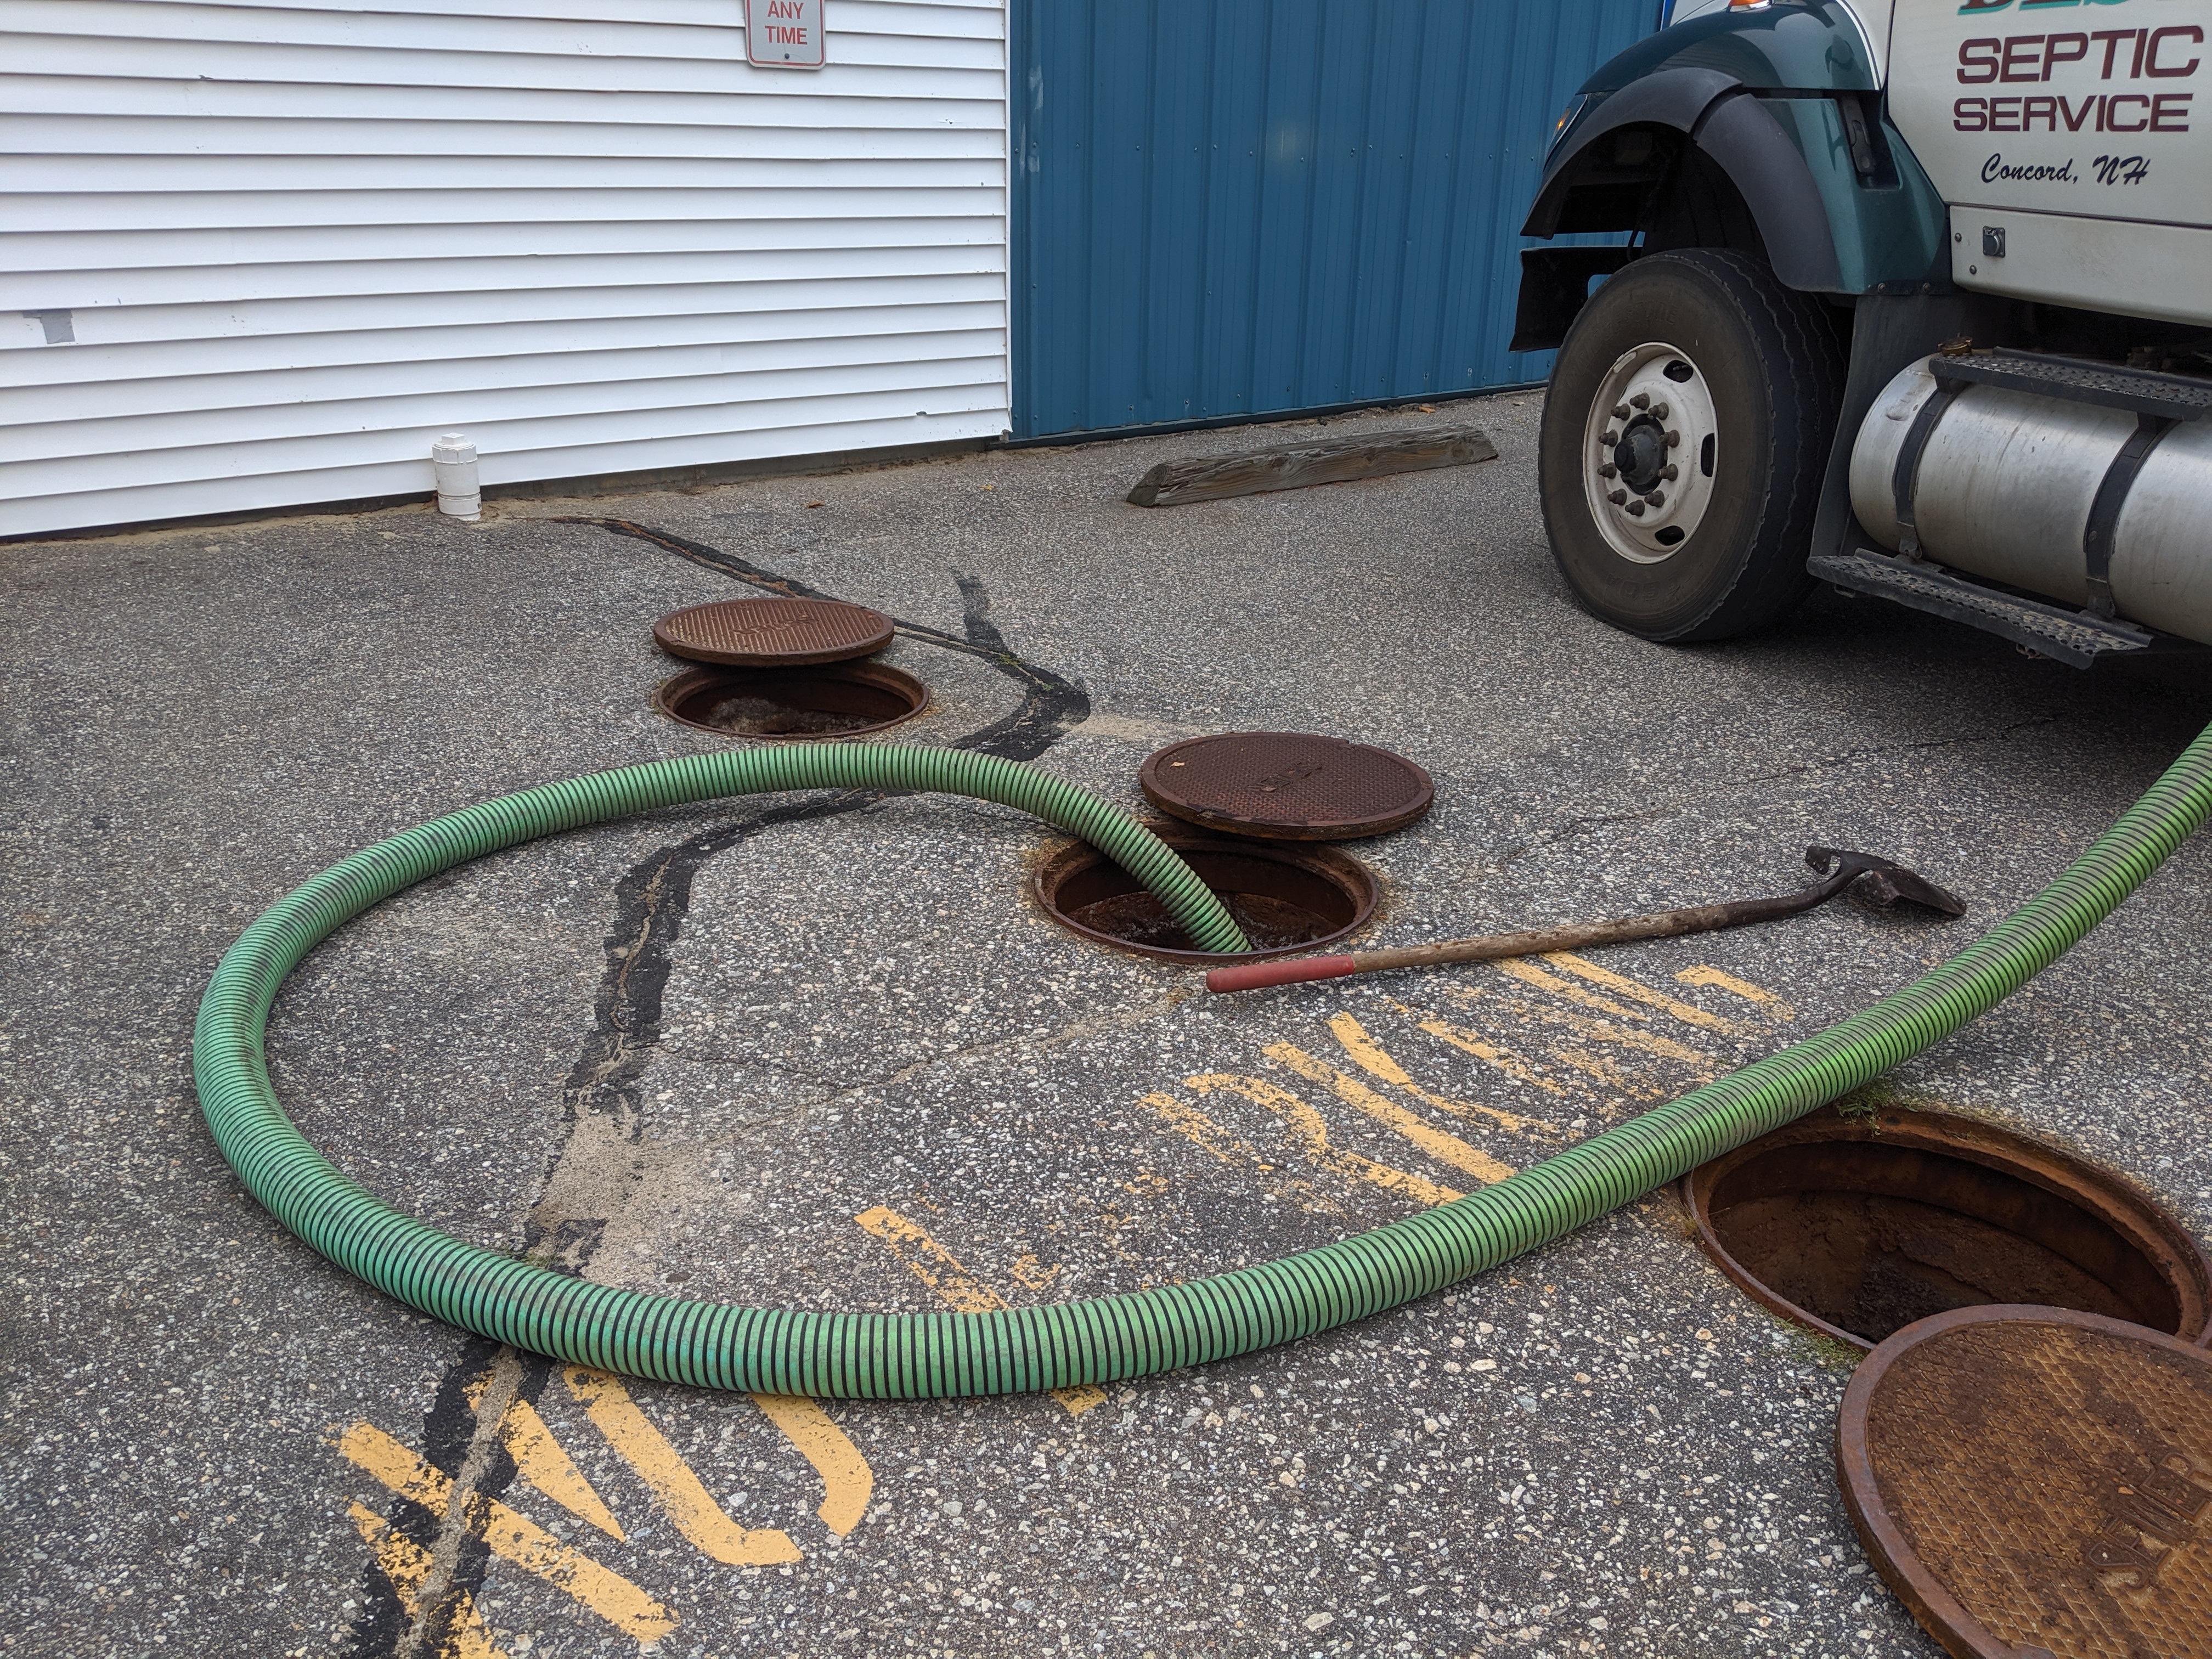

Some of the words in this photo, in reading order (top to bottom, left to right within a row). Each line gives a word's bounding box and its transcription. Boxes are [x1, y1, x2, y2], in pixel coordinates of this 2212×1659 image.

[768, 1, 804, 19] ANY
[765, 25, 808, 45] TIME
[1956, 25, 2204, 84] SEPTIC
[1953, 93, 2194, 132] SERVICE
[1981, 153, 2079, 185] Concord,
[2092, 155, 2152, 186] NH
